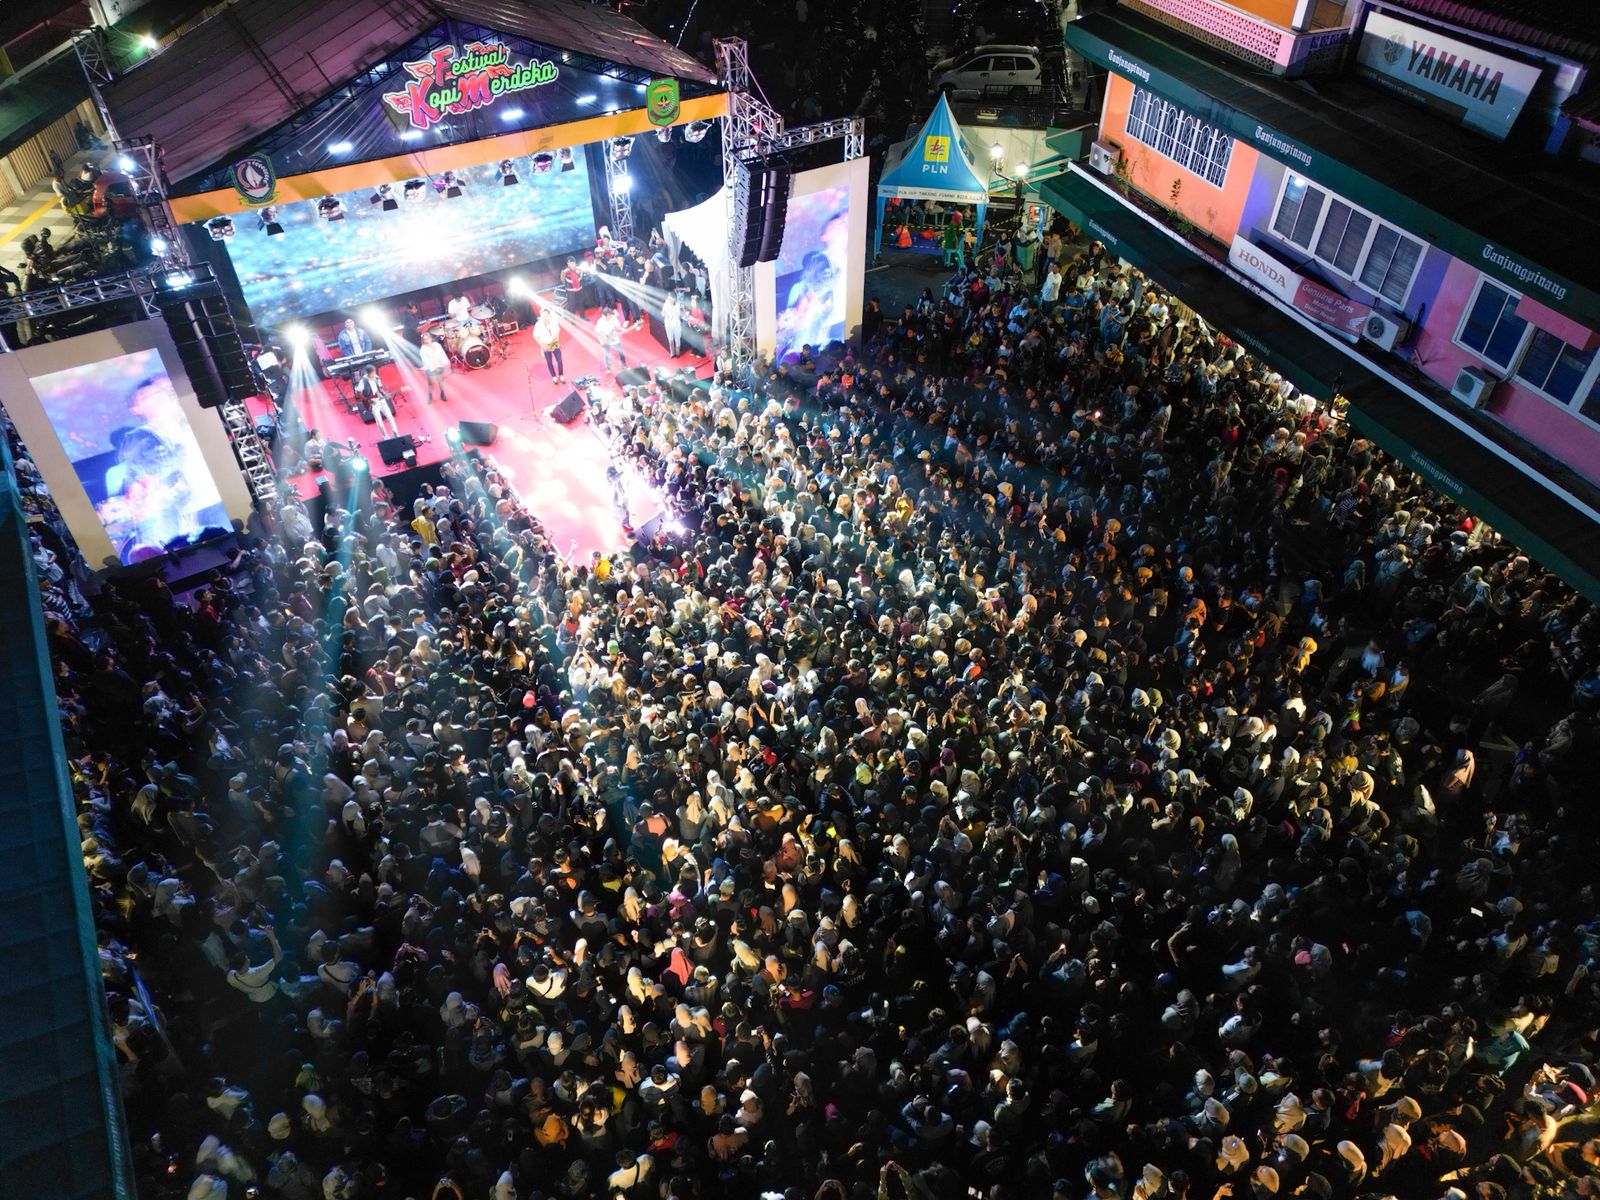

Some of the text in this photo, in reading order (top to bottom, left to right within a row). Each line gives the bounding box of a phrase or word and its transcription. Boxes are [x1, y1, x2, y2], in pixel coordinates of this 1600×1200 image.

[432, 45, 505, 86] Festival
[1407, 40, 1504, 105] YAMAHA
[408, 60, 556, 128] Kopi Merdeka
[1255, 125, 1312, 166] Tanjungpinang
[922, 164, 948, 174] PLN
[1238, 249, 1286, 288] HONDA
[1482, 243, 1567, 300] Tanjungpinang
[1333, 299, 1355, 314] Parts
[1410, 449, 1464, 495] Tanjungpinang
